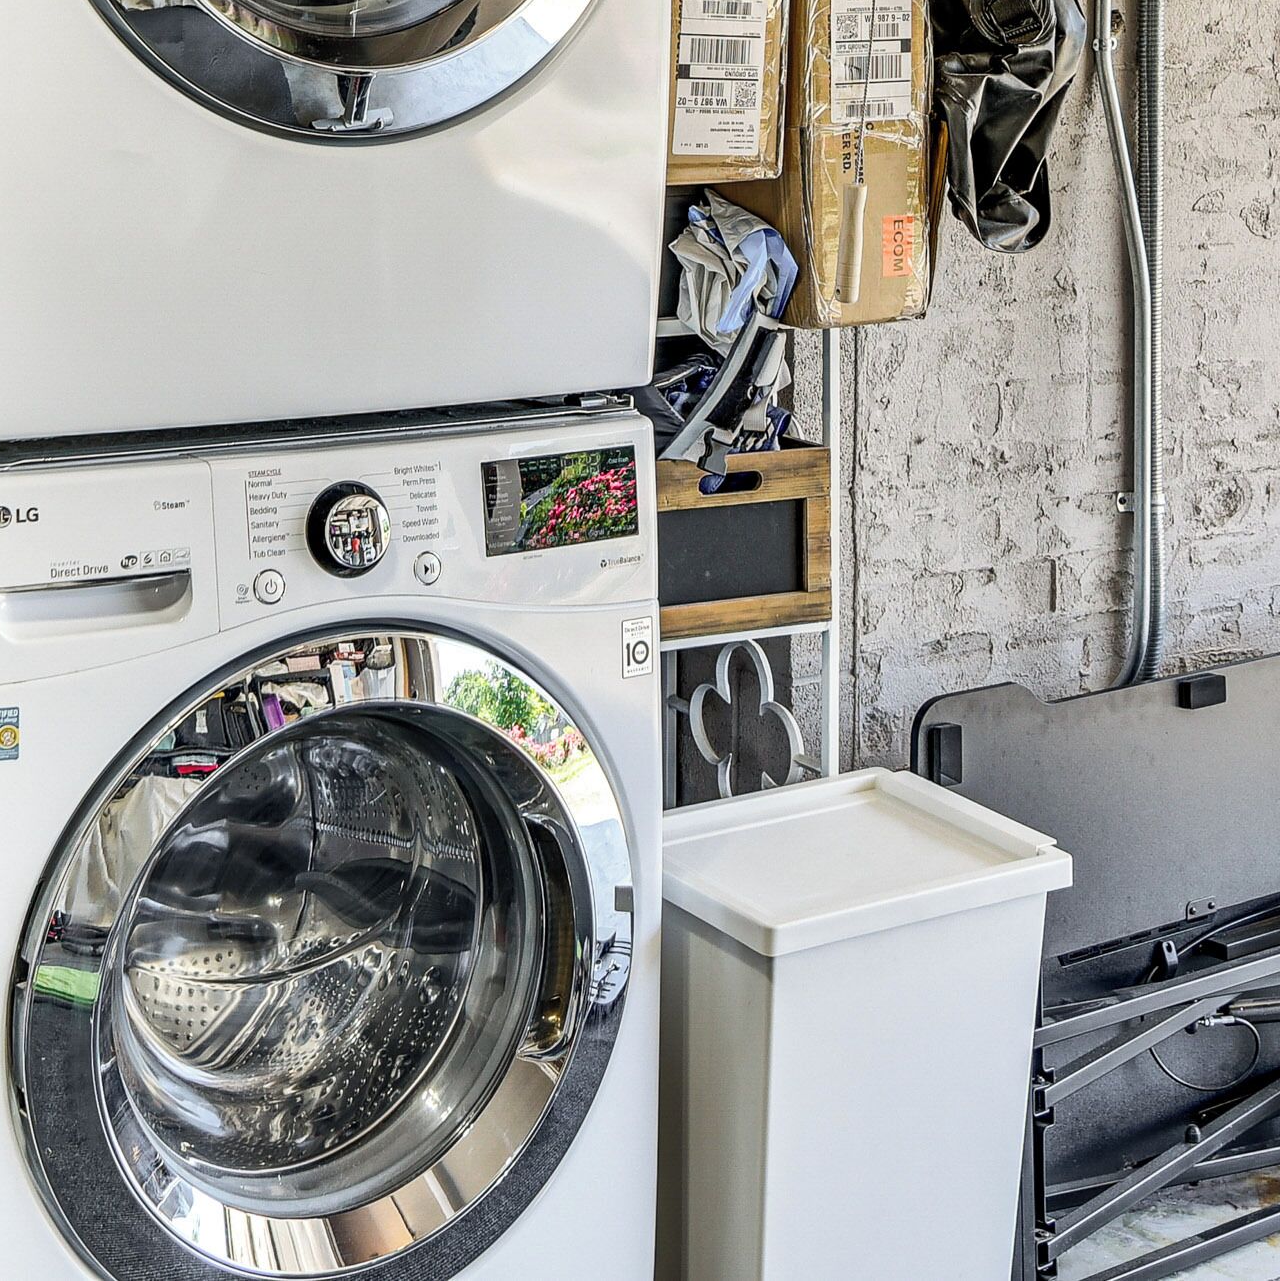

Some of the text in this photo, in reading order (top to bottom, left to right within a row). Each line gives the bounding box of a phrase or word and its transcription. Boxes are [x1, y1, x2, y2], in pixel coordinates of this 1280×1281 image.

[877, 14, 890, 22] 987
[700, 97, 714, 106] 987
[715, 97, 728, 107] WA
[842, 152, 851, 174] RD.
[893, 219, 904, 271] ECOM
[394, 467, 413, 476] Bright
[248, 479, 272, 488] Normal
[402, 477, 436, 487] Perm Press
[271, 491, 287, 499] Duty
[410, 491, 437, 500] Delicates
[250, 506, 278, 515] Bedding
[416, 504, 438, 513] Towels
[16, 507, 39, 523] LG
[250, 520, 280, 530] Sanitary
[402, 518, 439, 528] Speed Wash
[402, 532, 440, 543] Downloaded
[267, 549, 286, 557] Clean
[50, 564, 109, 579] Direct Drive
[626, 640, 650, 667] 10
